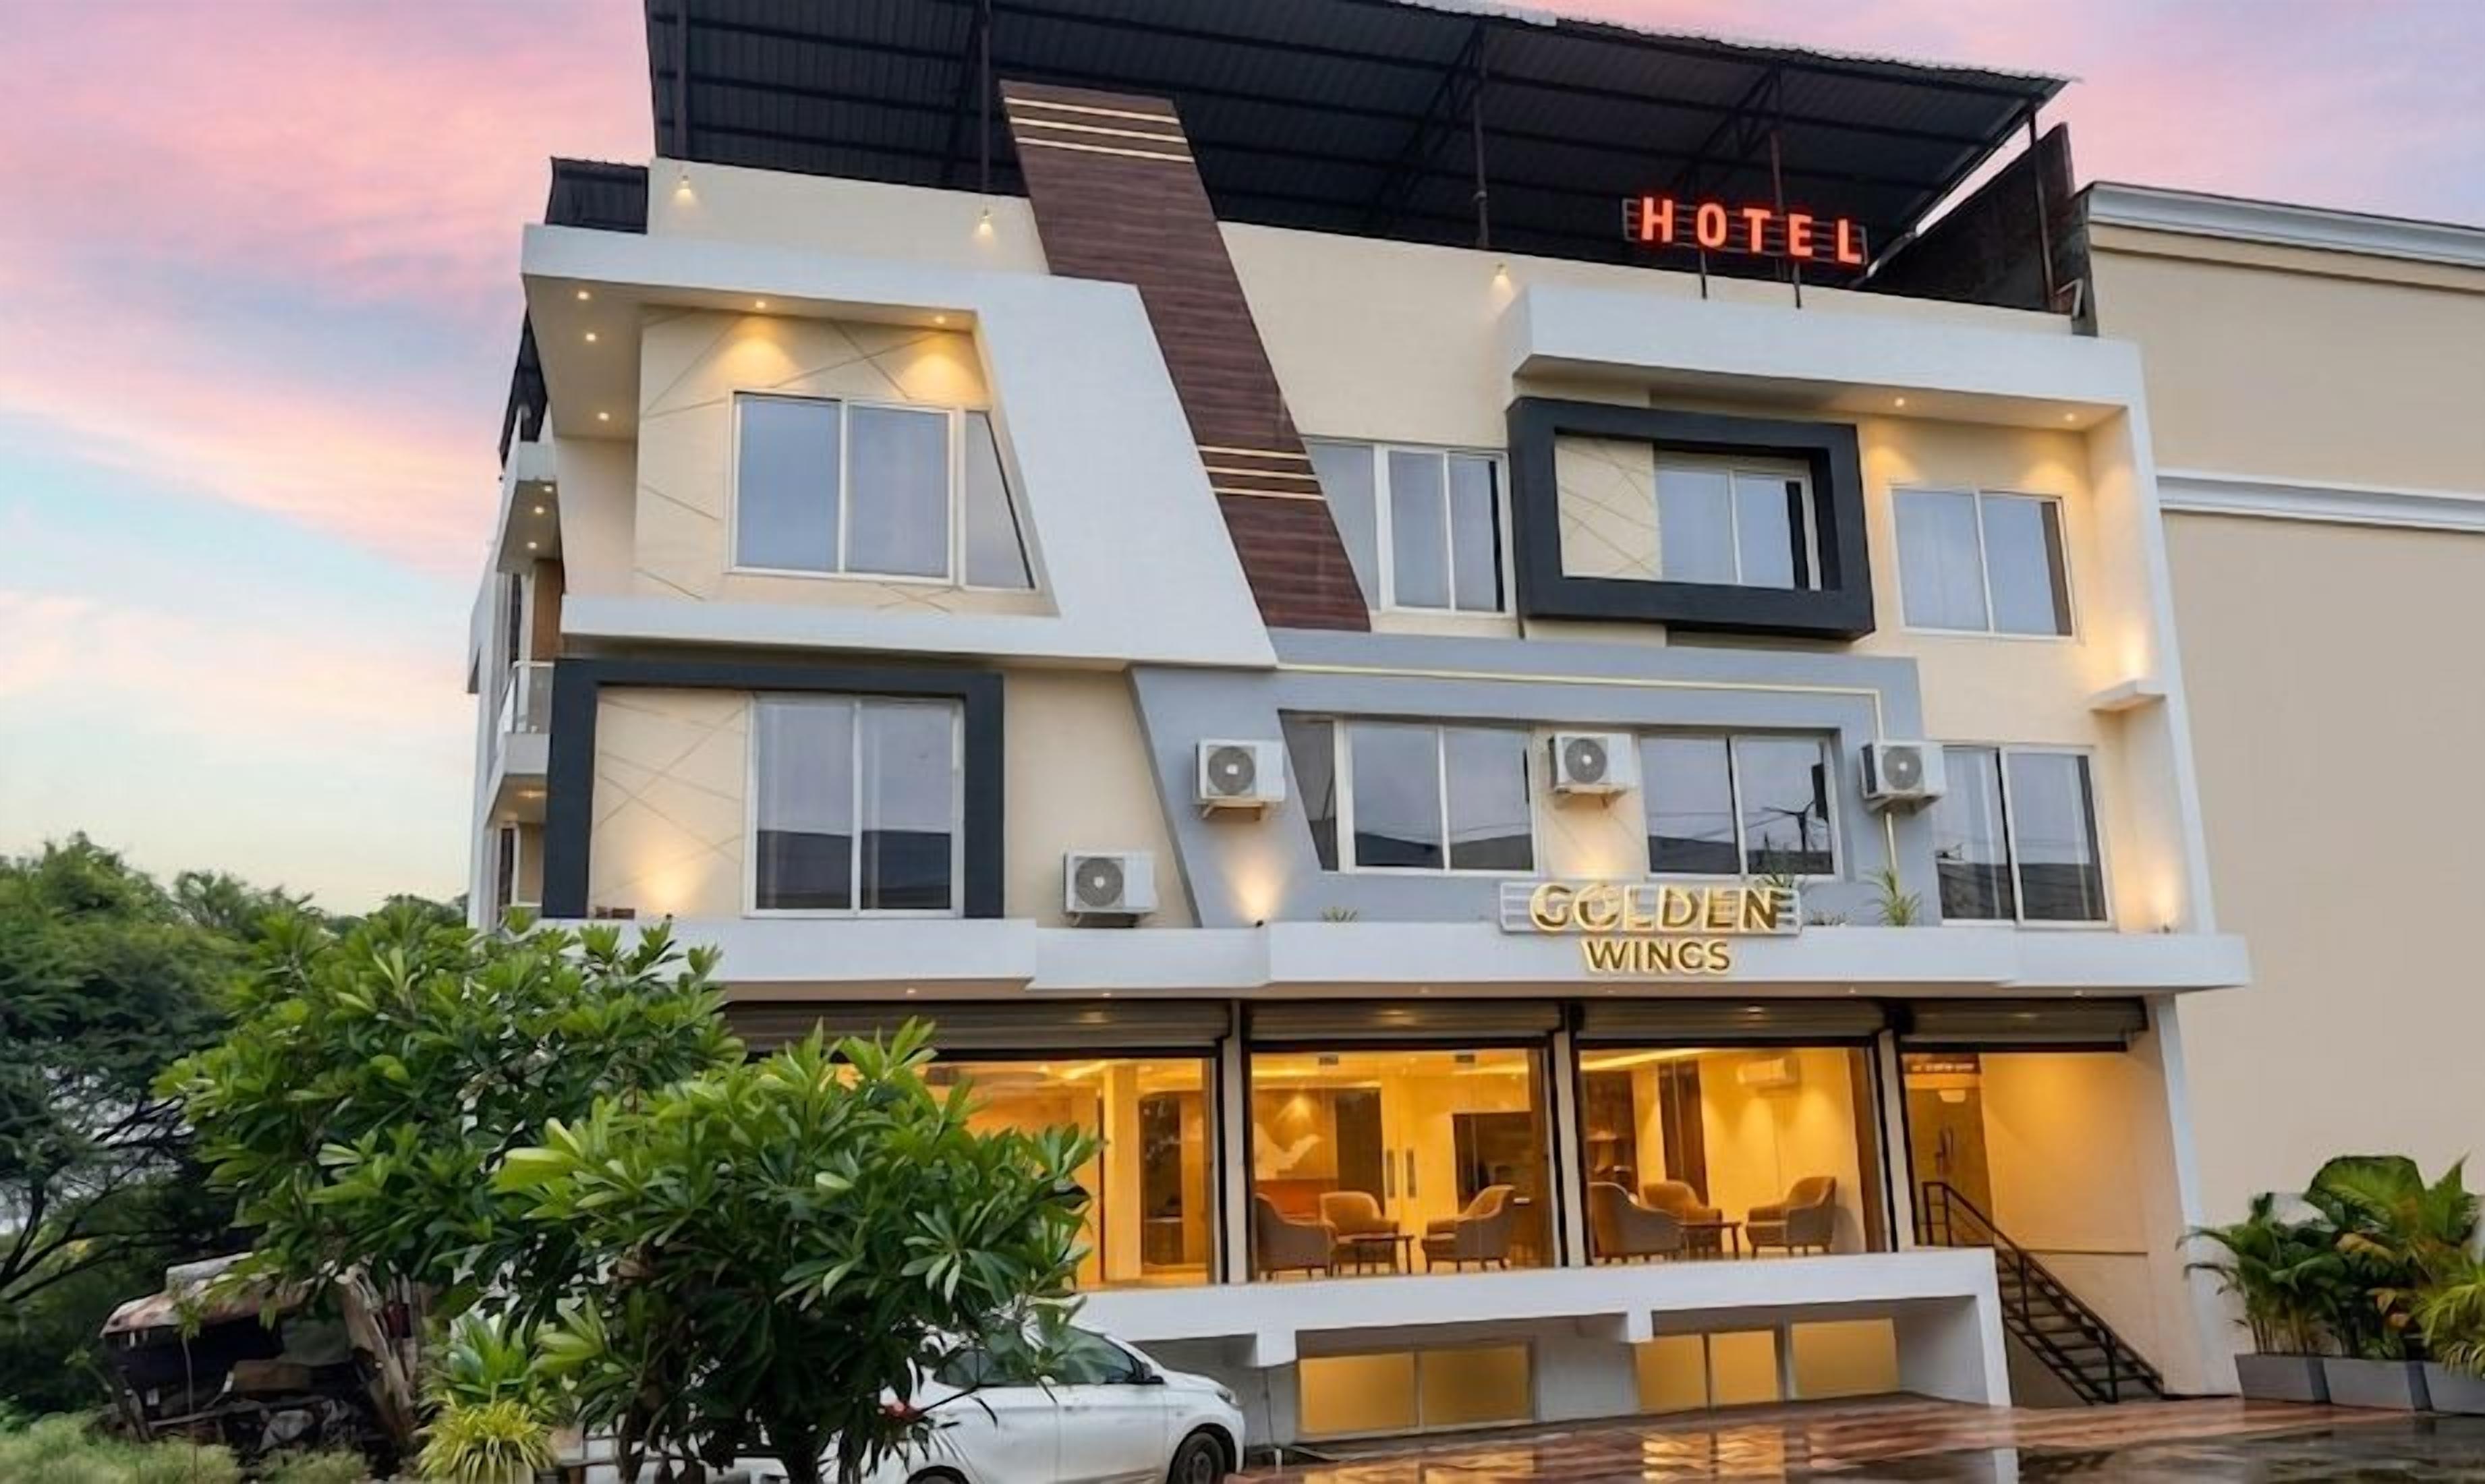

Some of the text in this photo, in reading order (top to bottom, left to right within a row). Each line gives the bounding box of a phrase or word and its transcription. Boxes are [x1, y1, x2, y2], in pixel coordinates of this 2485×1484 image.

[1641, 197, 1864, 264] HOTEL
[1529, 883, 1779, 932] GOLDEN
[1582, 938, 1732, 973] WINGS
